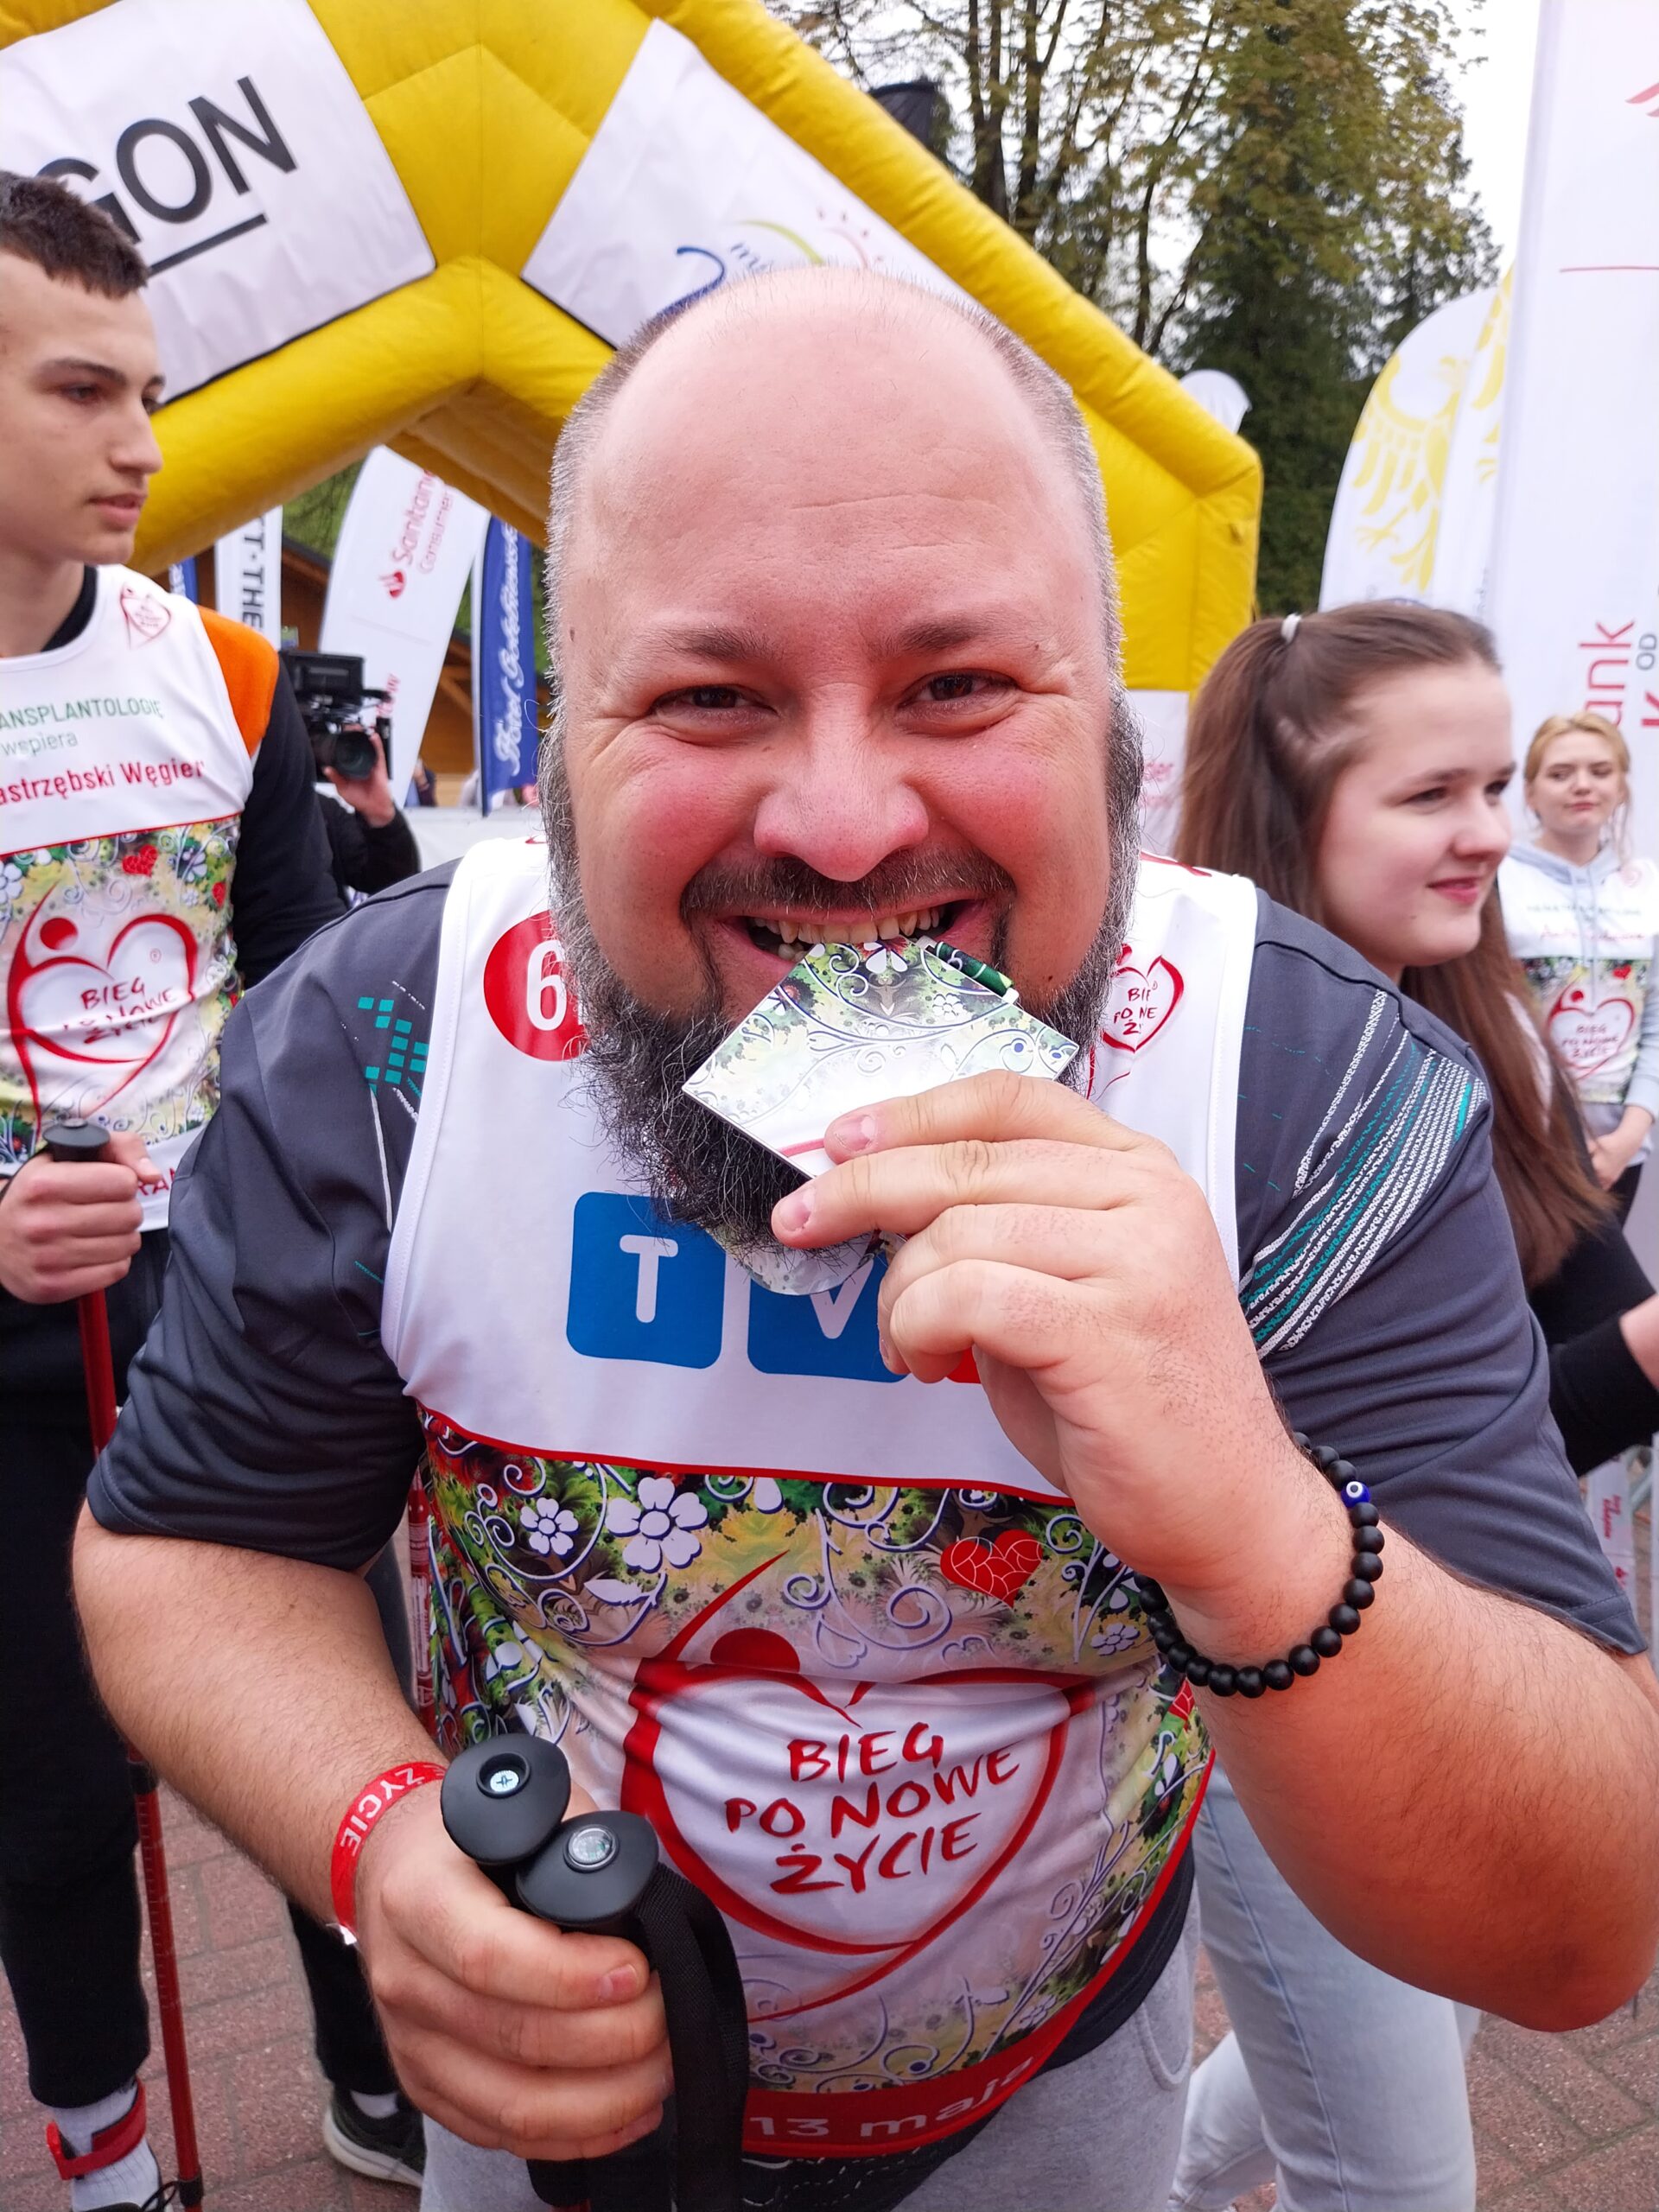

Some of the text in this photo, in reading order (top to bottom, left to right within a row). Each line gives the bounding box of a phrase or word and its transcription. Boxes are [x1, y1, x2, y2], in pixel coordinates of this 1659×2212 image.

[243, 567, 264, 629] THE
[1, 732, 78, 757] wspiera
[81, 976, 145, 1009] BIEG
[526, 939, 583, 1031] 6
[787, 1722, 944, 1783] BIEG
[340, 1768, 425, 1857] ŻYCIE
[724, 1739, 1023, 1838] PO NOWE
[770, 1812, 982, 1894] ŻYCIE
[749, 2118, 830, 2137] 13
